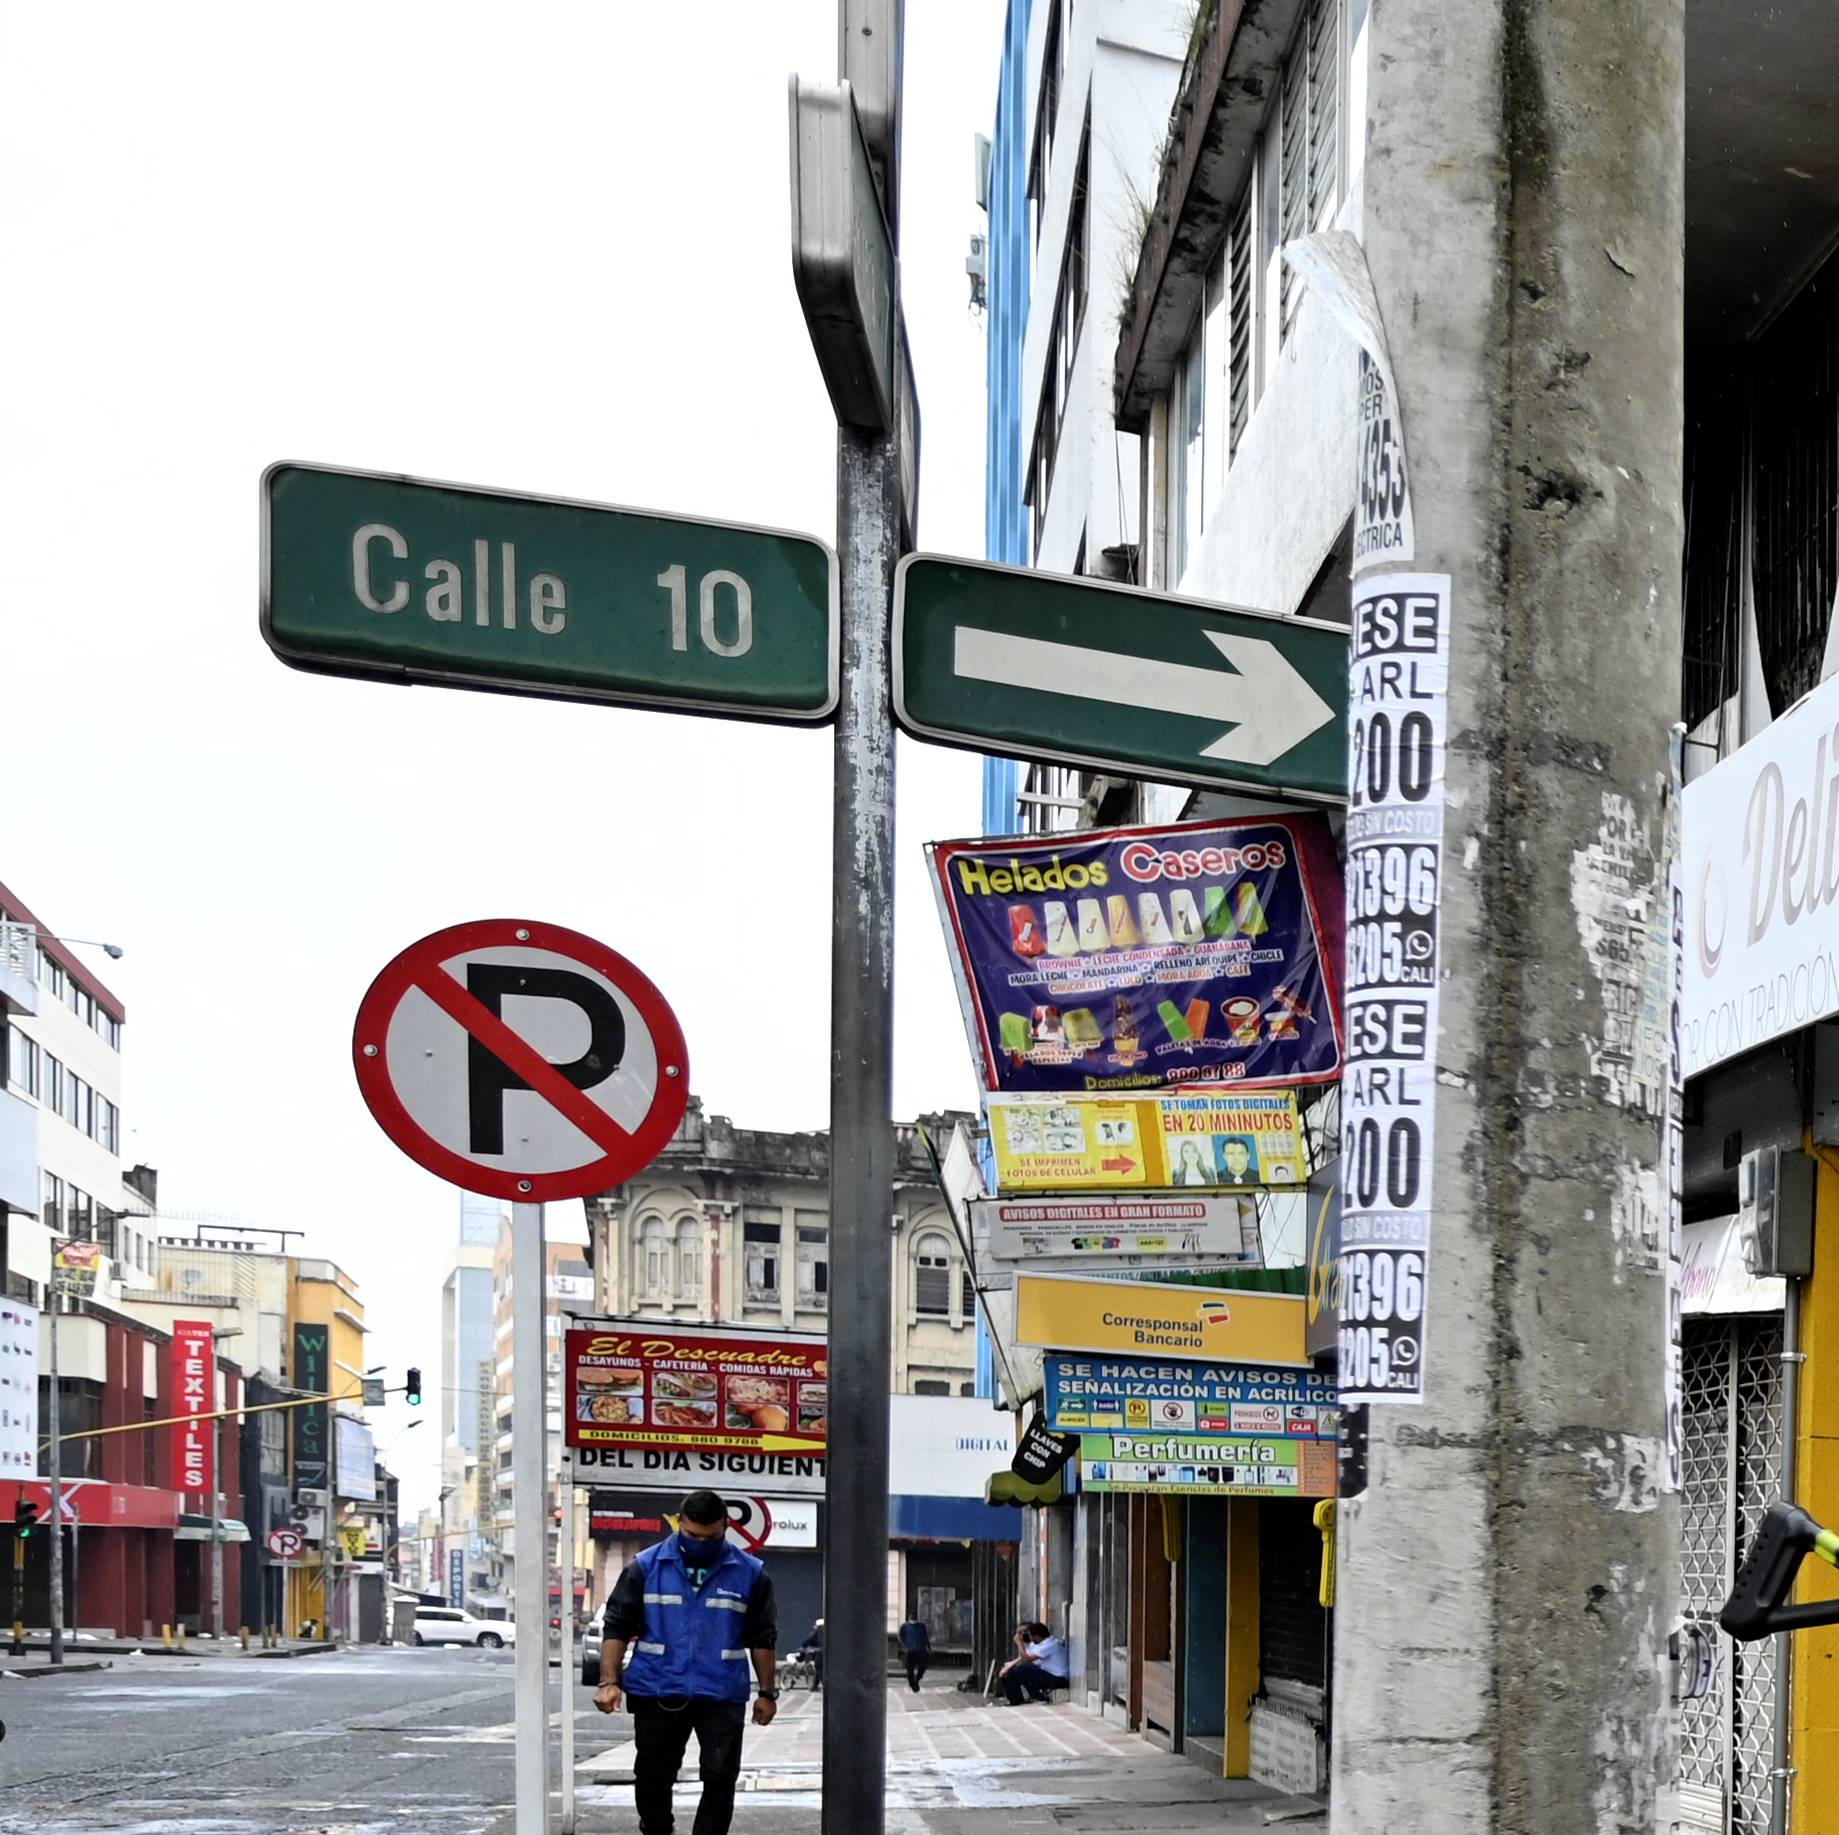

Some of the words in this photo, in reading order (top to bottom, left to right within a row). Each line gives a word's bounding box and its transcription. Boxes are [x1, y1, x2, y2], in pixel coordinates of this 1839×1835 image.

[351, 524, 567, 636] Calle
[655, 563, 754, 657] 10
[1361, 661, 1434, 704] ARL
[1384, 811, 1436, 834] COSTO
[958, 855, 1110, 896] Helados
[1120, 840, 1286, 883] Caseros
[1401, 966, 1434, 983] CALI
[1704, 990, 1746, 1060] CON
[1351, 1066, 1422, 1107] ARL
[1162, 1114, 1184, 1132] EN
[1187, 1113, 1205, 1132] 20
[1209, 1112, 1293, 1132] MININUTOS
[1054, 1167, 1097, 1177] CELULAR
[1003, 1207, 1046, 1220] AVISOS
[1046, 1206, 1103, 1220] DIGITALES
[1104, 1206, 1118, 1218] EN
[1120, 1205, 1150, 1218] GRAN
[1152, 1204, 1204, 1218] FORMATO
[1102, 1312, 1204, 1333] Corresponsal
[586, 1337, 632, 1357] El
[1134, 1330, 1204, 1348] Bancario
[578, 1355, 642, 1368] DESAYUNOS
[719, 1363, 768, 1376] COMIDAS
[769, 1364, 814, 1378] RÁPIDAS
[1058, 1363, 1092, 1378] SE
[1101, 1364, 1194, 1381] HACEN
[1202, 1368, 1299, 1386] AVISOS
[1306, 1373, 1338, 1386] DE
[1058, 1377, 1209, 1400] SEÑALIZACIÓN
[1215, 1384, 1242, 1400] EN
[1247, 1384, 1339, 1403] ACRÍLICO
[1387, 1371, 1419, 1388] CALI
[184, 1339, 204, 1488] TEXTILES
[1030, 1428, 1063, 1455] LLAVES
[1030, 1443, 1051, 1458] CON
[1112, 1434, 1277, 1463] Perfumería
[580, 1449, 633, 1469] DEL
[1023, 1451, 1046, 1468] CHIP
[1169, 1484, 1211, 1494] Esencias
[1213, 1485, 1226, 1494] de
[1228, 1486, 1275, 1496] Perfumes
